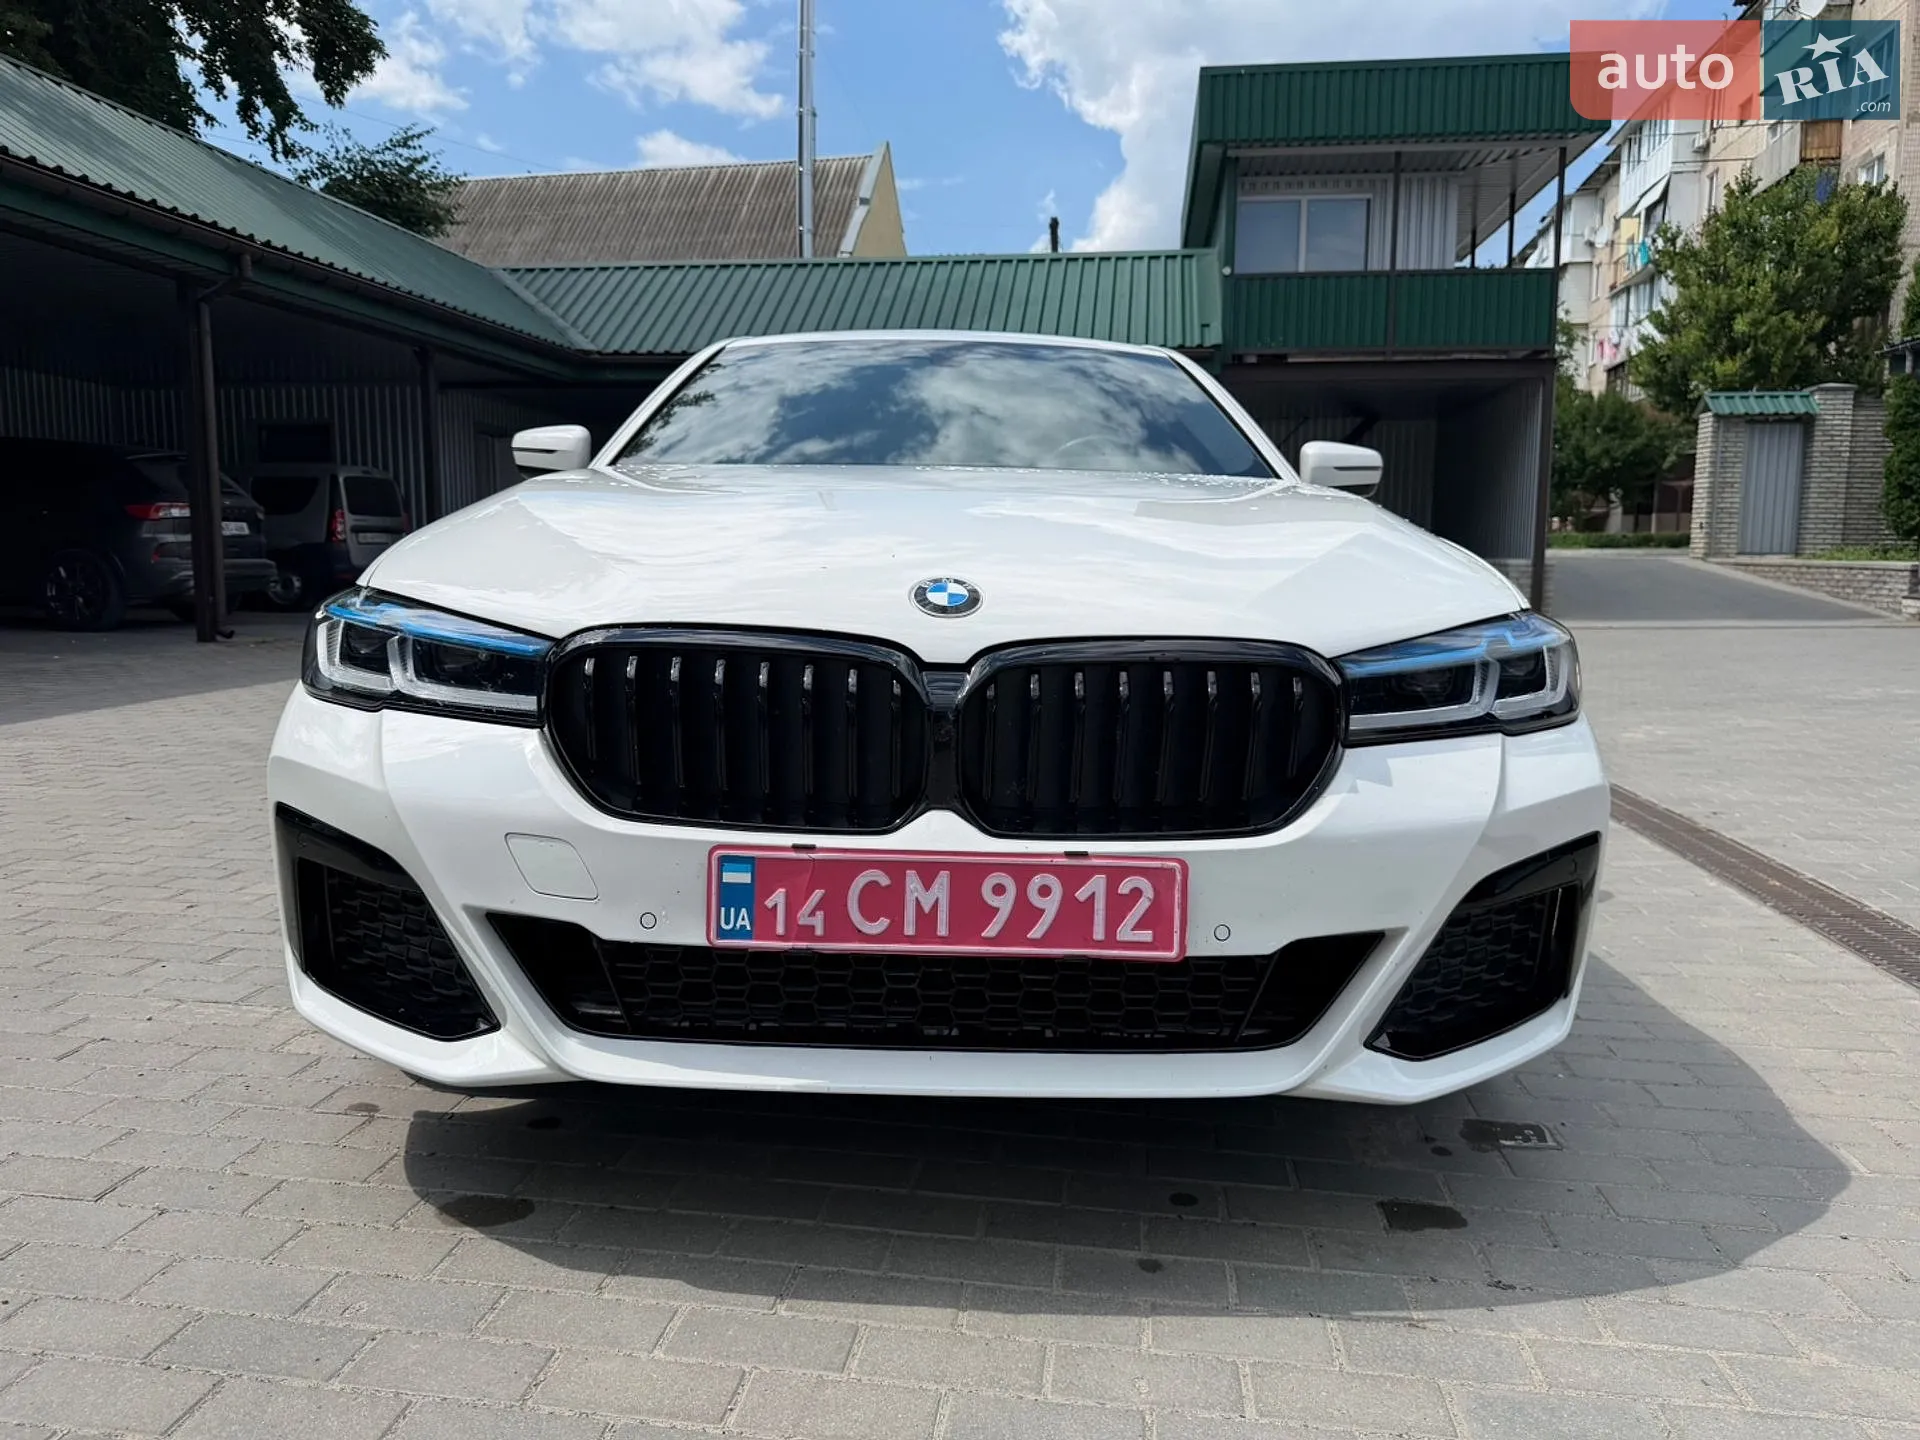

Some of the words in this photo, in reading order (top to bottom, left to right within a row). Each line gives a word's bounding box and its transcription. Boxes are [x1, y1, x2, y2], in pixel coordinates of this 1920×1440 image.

[720, 907, 751, 930] UA
[764, 888, 826, 936] 14
[847, 869, 950, 936] CM
[981, 872, 1154, 942] 9912
